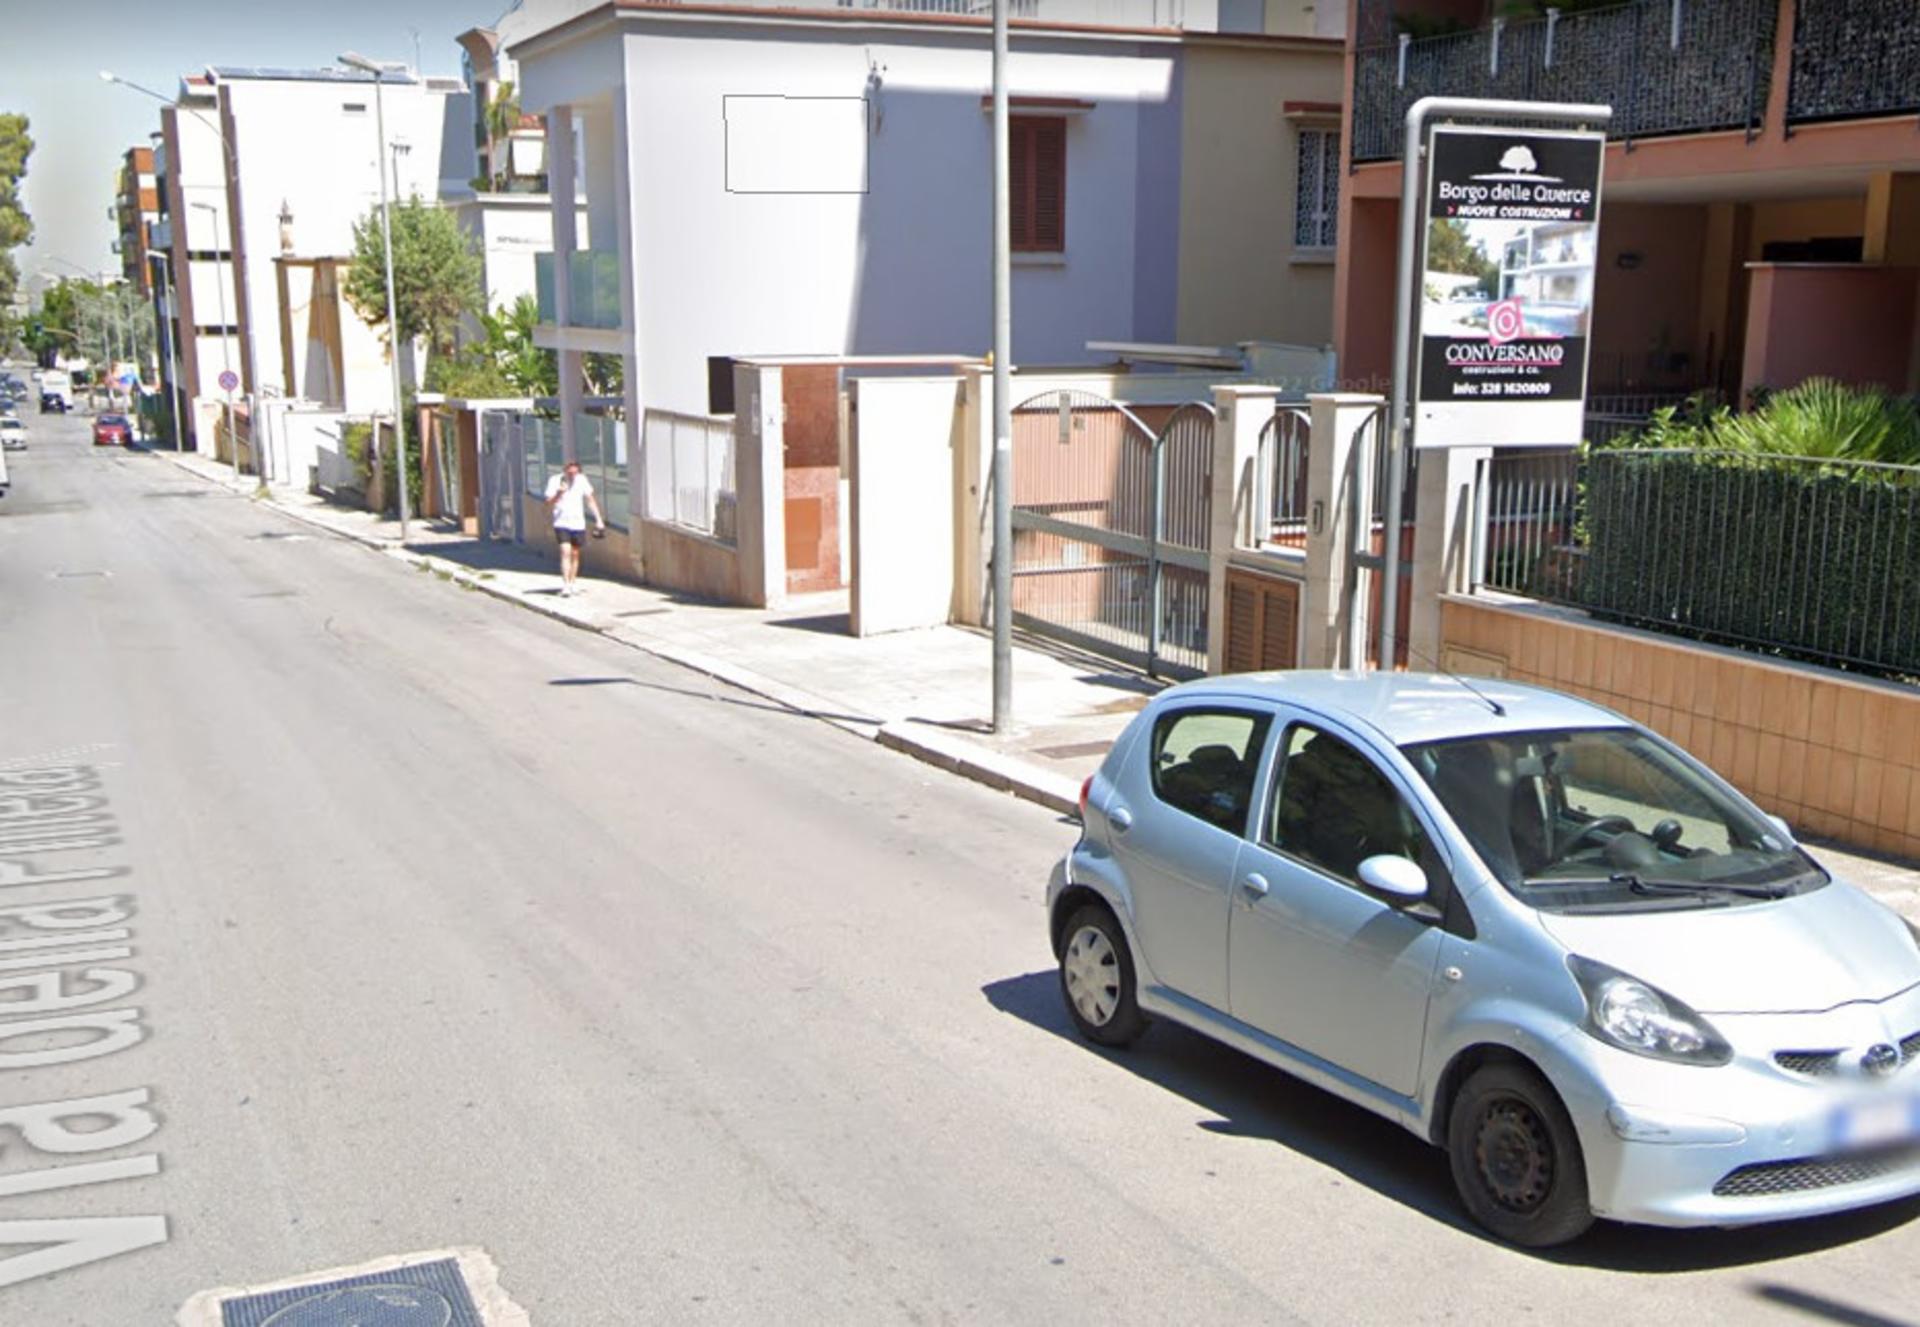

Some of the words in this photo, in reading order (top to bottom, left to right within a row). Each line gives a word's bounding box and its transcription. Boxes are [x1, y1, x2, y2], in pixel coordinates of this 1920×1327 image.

[1439, 181, 1488, 205] Borgo
[1490, 184, 1531, 202] delle
[1533, 185, 1592, 203] Querce
[1457, 205, 1497, 217] NUOVE
[1499, 206, 1572, 219] COSTRUZIONI
[1445, 344, 1564, 361] CONVERSANO
